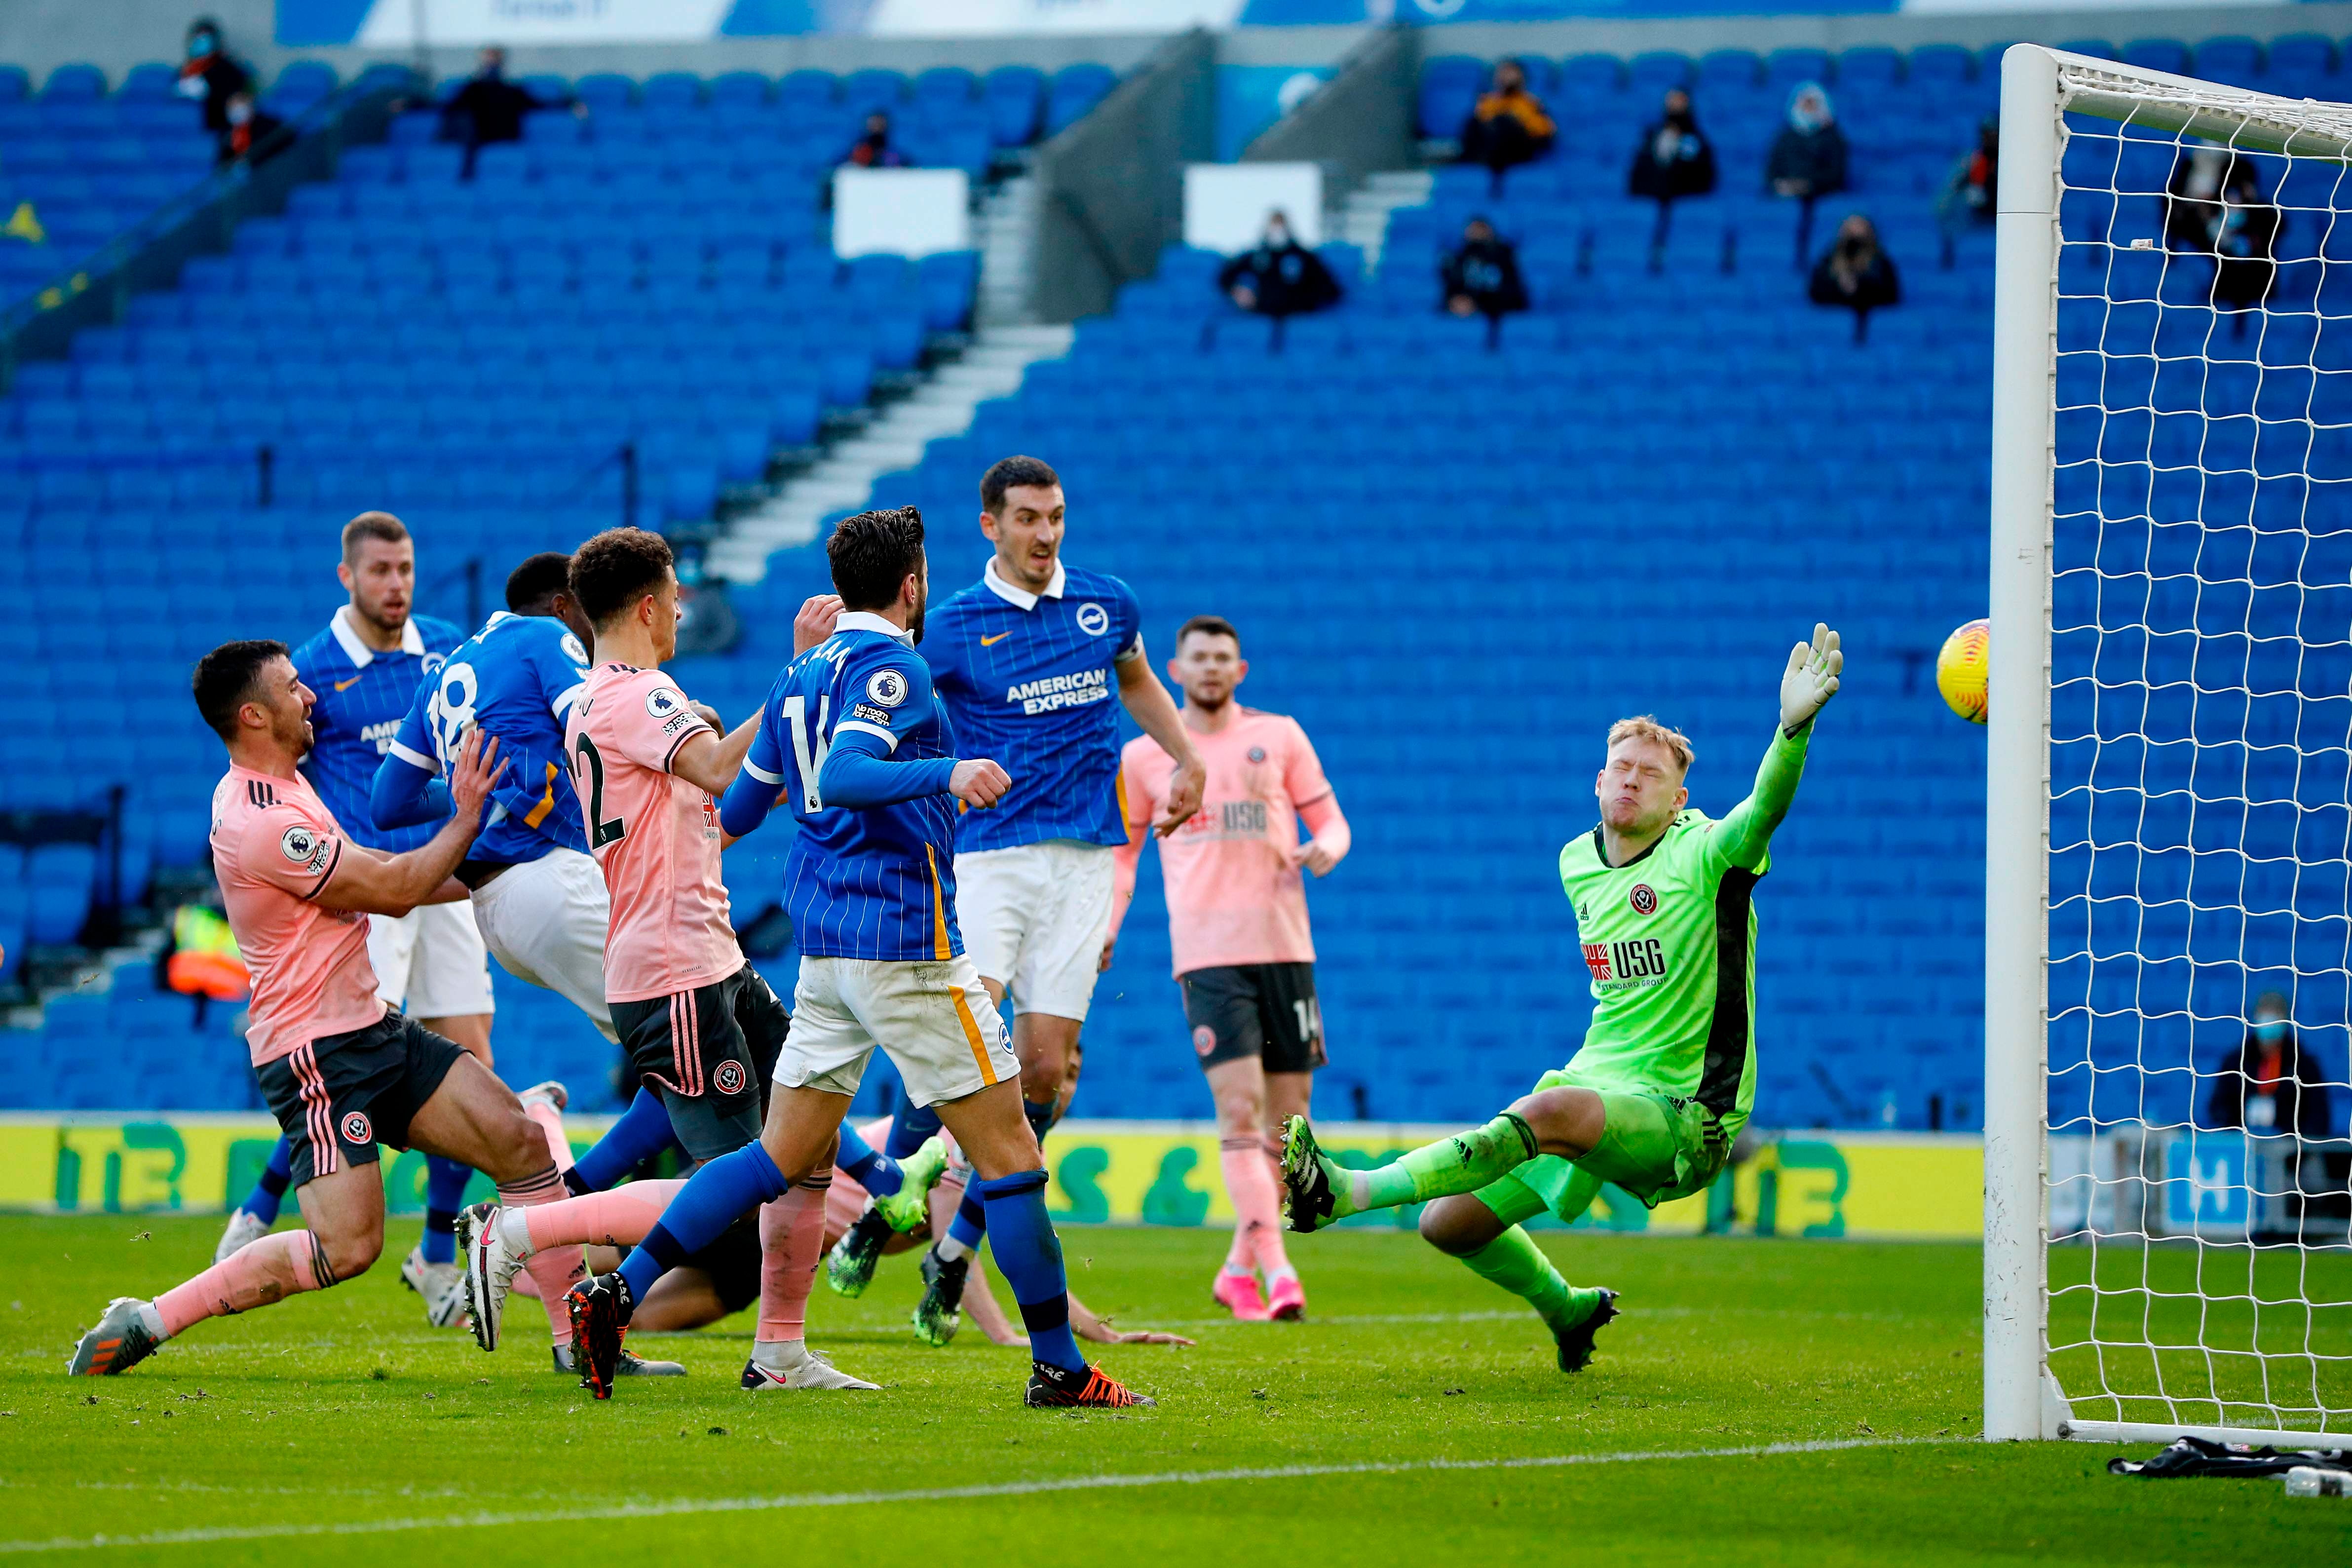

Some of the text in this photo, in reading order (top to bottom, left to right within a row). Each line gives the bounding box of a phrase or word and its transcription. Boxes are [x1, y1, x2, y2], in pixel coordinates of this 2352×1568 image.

[1007, 668, 1106, 703] AMERICAN
[1023, 685, 1109, 716] EXPRESS
[662, 722, 674, 732] No
[854, 704, 888, 721] No room
[864, 713, 890, 727] racism
[564, 731, 626, 851] 2
[1223, 801, 1267, 833] USG
[1613, 939, 1666, 979] USG
[1601, 981, 1639, 992] STANDARD
[1641, 978, 1669, 987] GROUP
